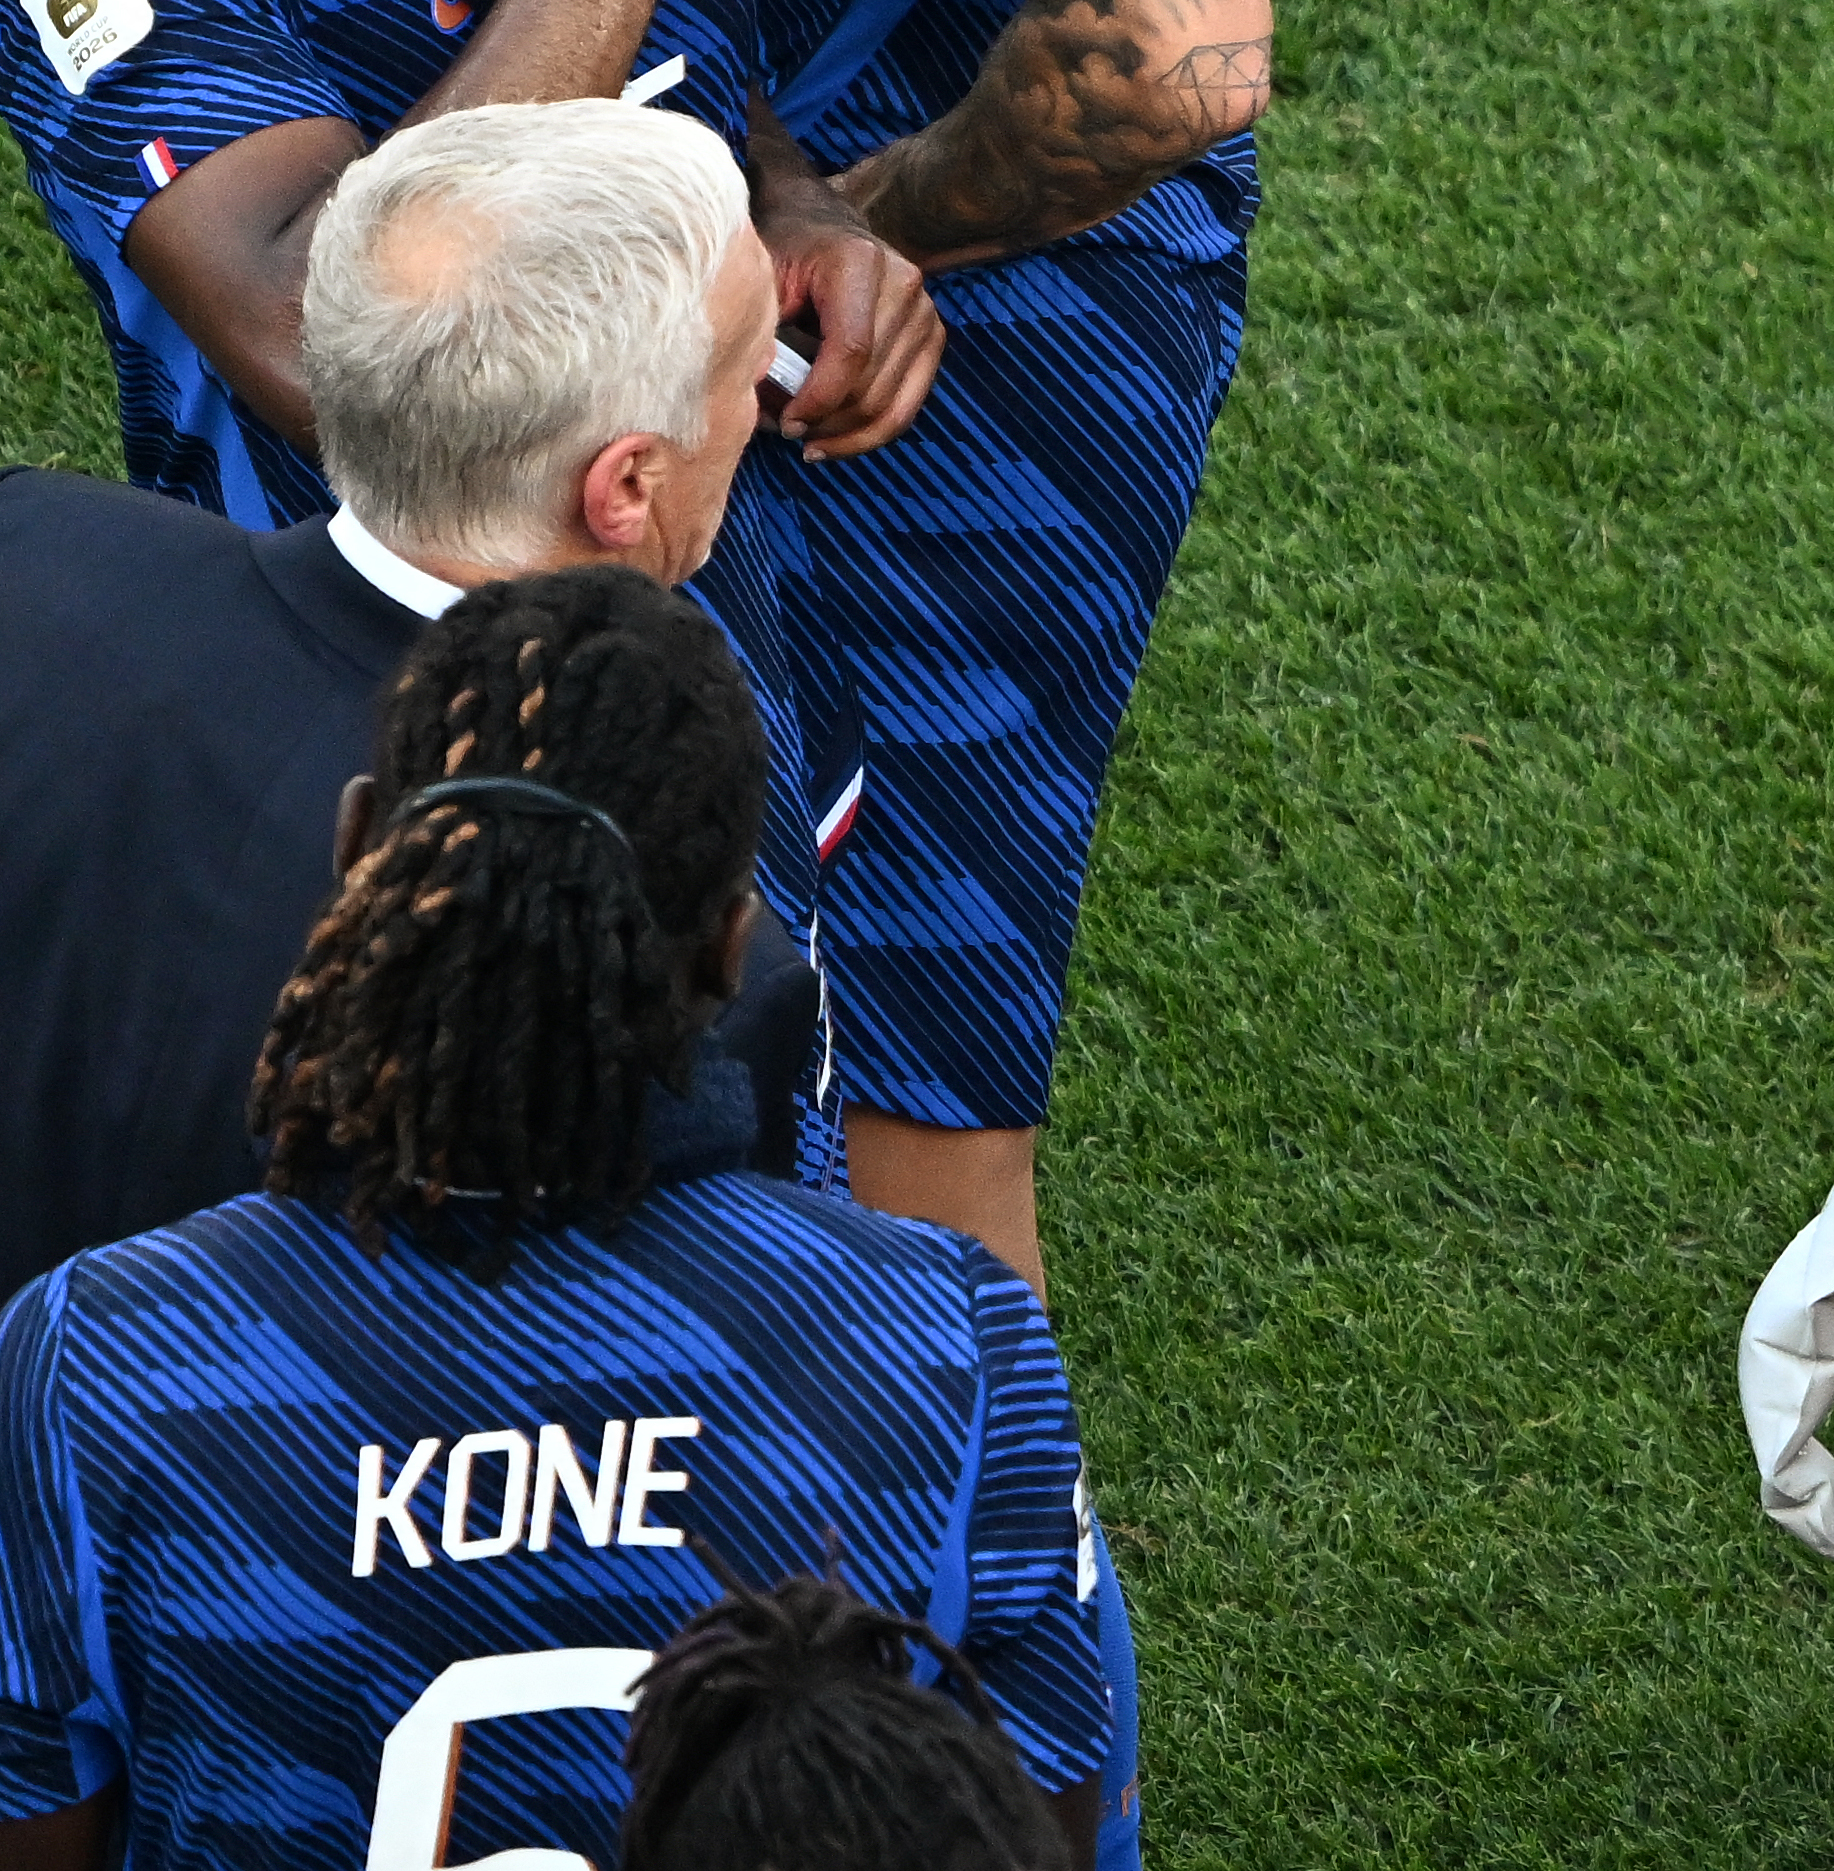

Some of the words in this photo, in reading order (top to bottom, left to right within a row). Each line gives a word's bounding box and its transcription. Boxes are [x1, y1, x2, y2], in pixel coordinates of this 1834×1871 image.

[62, 2, 88, 28] FIFA
[67, 30, 90, 57] WORLD
[91, 15, 109, 34] CUP
[71, 28, 119, 72] 2026
[351, 1416, 700, 1578] KONE
